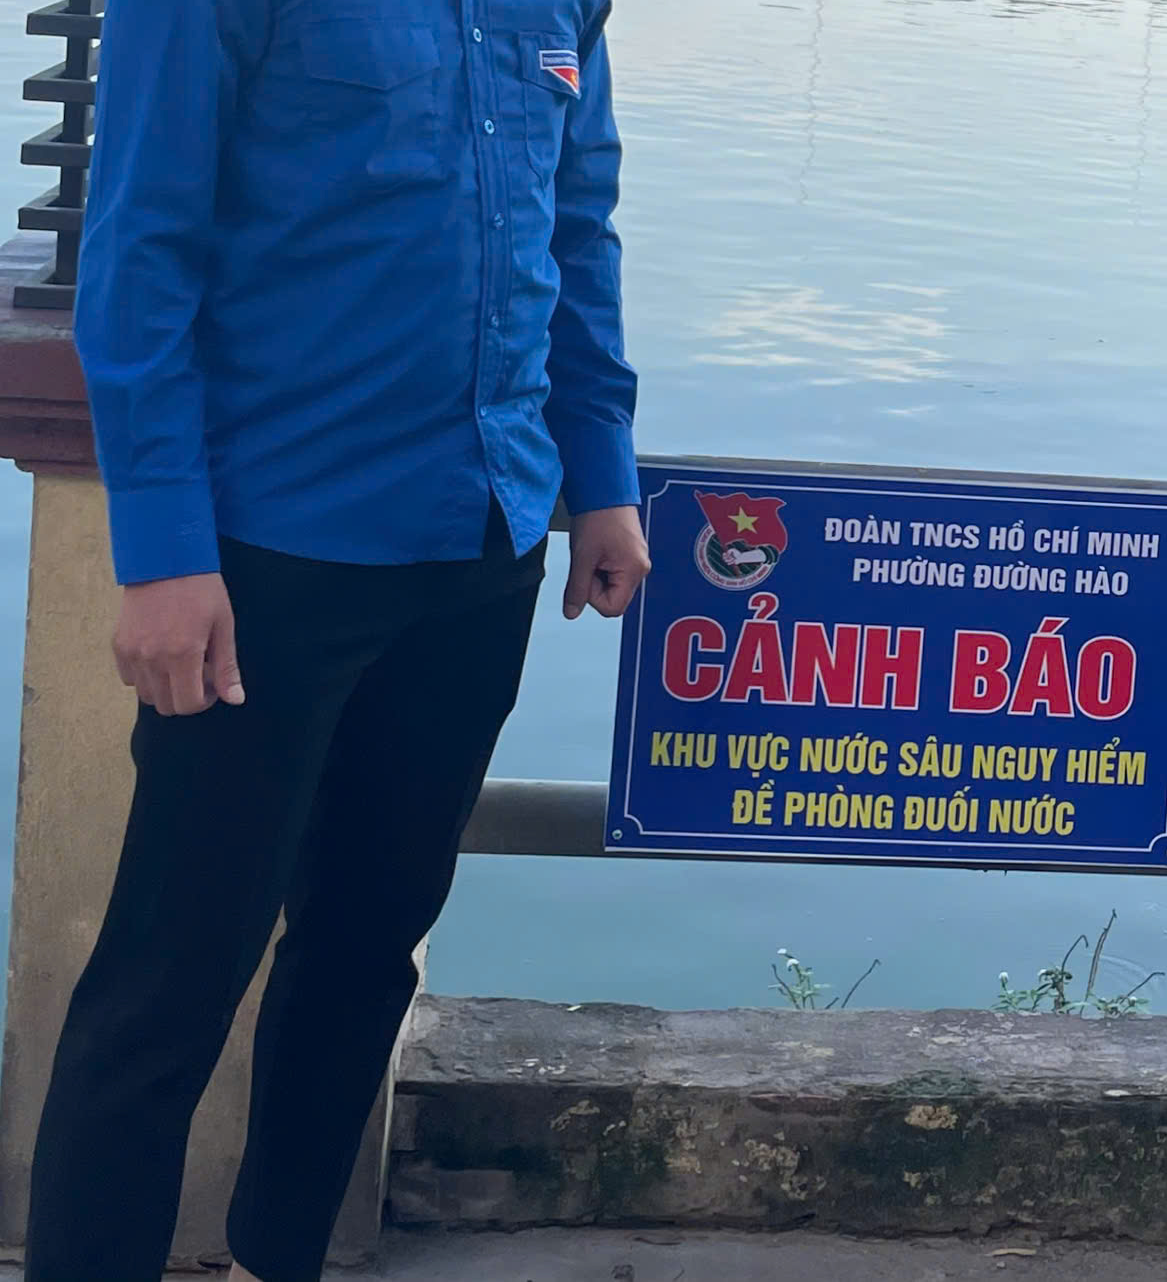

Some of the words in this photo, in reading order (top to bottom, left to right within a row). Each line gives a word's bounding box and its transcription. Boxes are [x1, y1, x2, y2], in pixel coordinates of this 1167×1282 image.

[825, 515, 900, 544] ĐOÀN
[910, 523, 979, 548] TNCS
[989, 520, 1024, 550] HỒ
[1034, 526, 1078, 553] CHÍ
[1088, 532, 1159, 557] MINH
[854, 556, 964, 586] PHƯỜNG
[974, 561, 1066, 592] ĐƯỜNG
[1076, 566, 1128, 595] HÀO
[663, 592, 924, 710] CẢNH
[949, 617, 1136, 720] BÁO
[652, 732, 716, 767] KHU
[728, 733, 789, 777] VỰC
[800, 733, 887, 774] NƯỚC
[899, 736, 962, 777] SÂU
[972, 746, 1057, 781] NGUY
[1067, 737, 1146, 785] HIỂM
[733, 780, 774, 824] ĐỀ
[784, 785, 893, 829] PHÒNG
[904, 786, 978, 832] ĐUỐI
[989, 794, 1074, 835] NƯỚC
